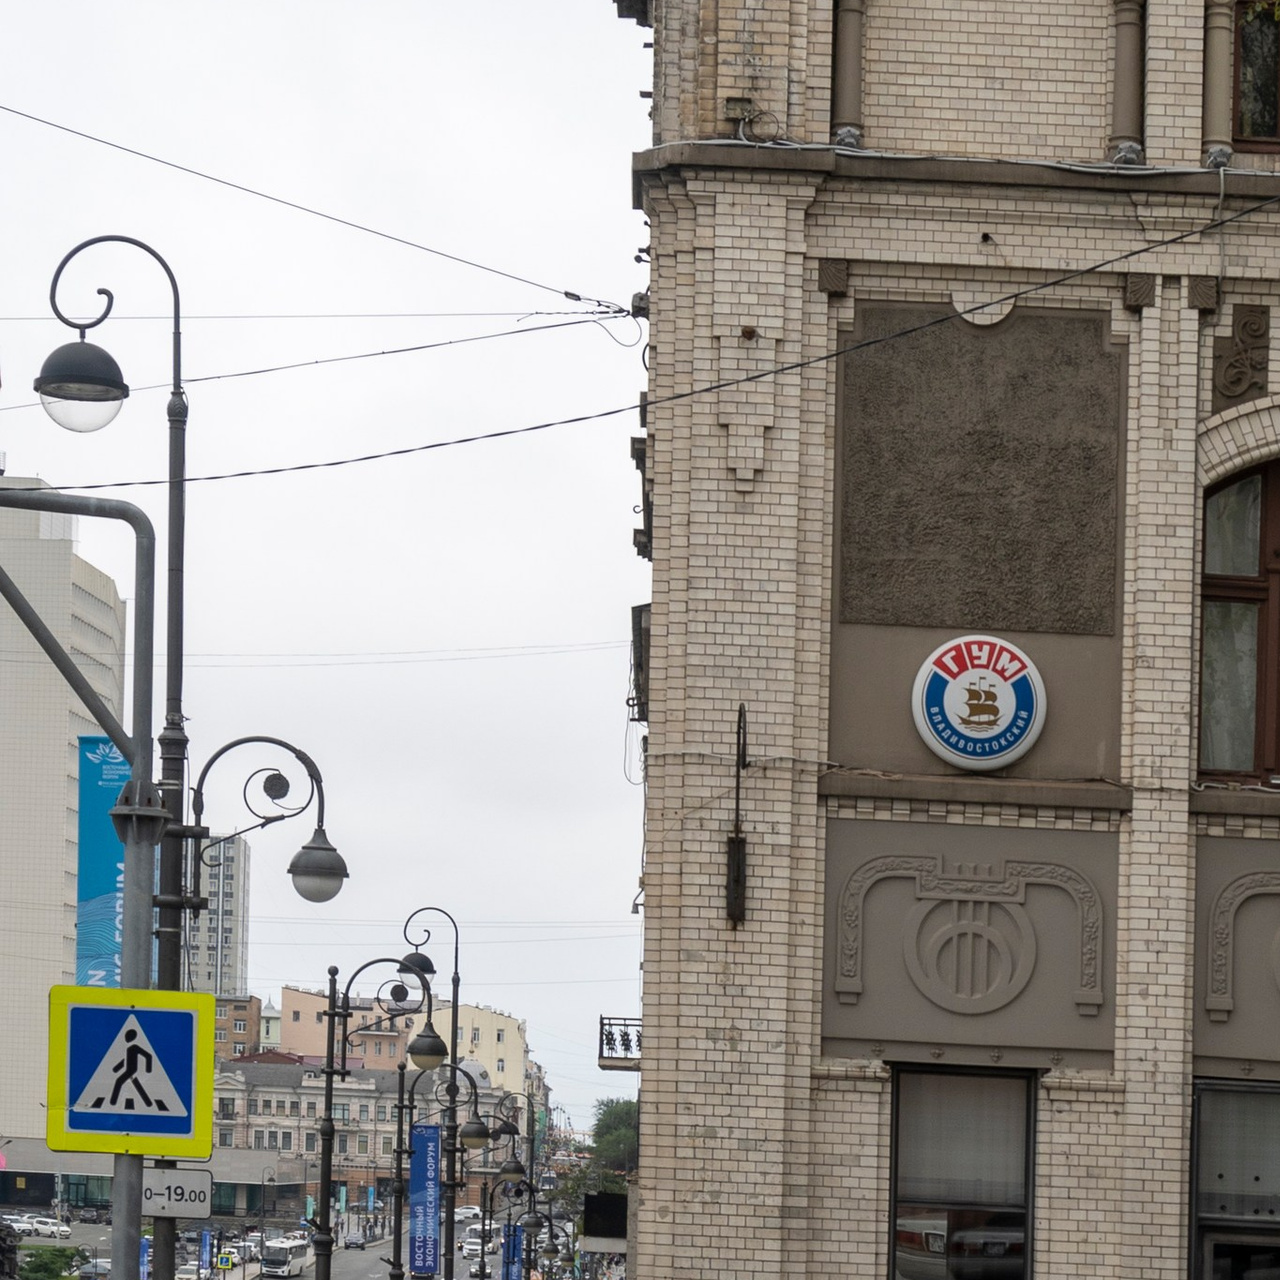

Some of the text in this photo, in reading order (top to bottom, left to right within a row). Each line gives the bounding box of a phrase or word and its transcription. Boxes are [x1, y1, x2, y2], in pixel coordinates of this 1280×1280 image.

[941, 644, 1022, 678] ГУМ
[930, 706, 1029, 753] ВЛАДИВОСТОКСКИЙ
[427, 1142, 436, 1178] ФОРУМ
[414, 1206, 424, 1267] ВОСТОЧНЫЙ
[425, 1181, 435, 1267] ЭКОНОМИЧЕСКИЙ
